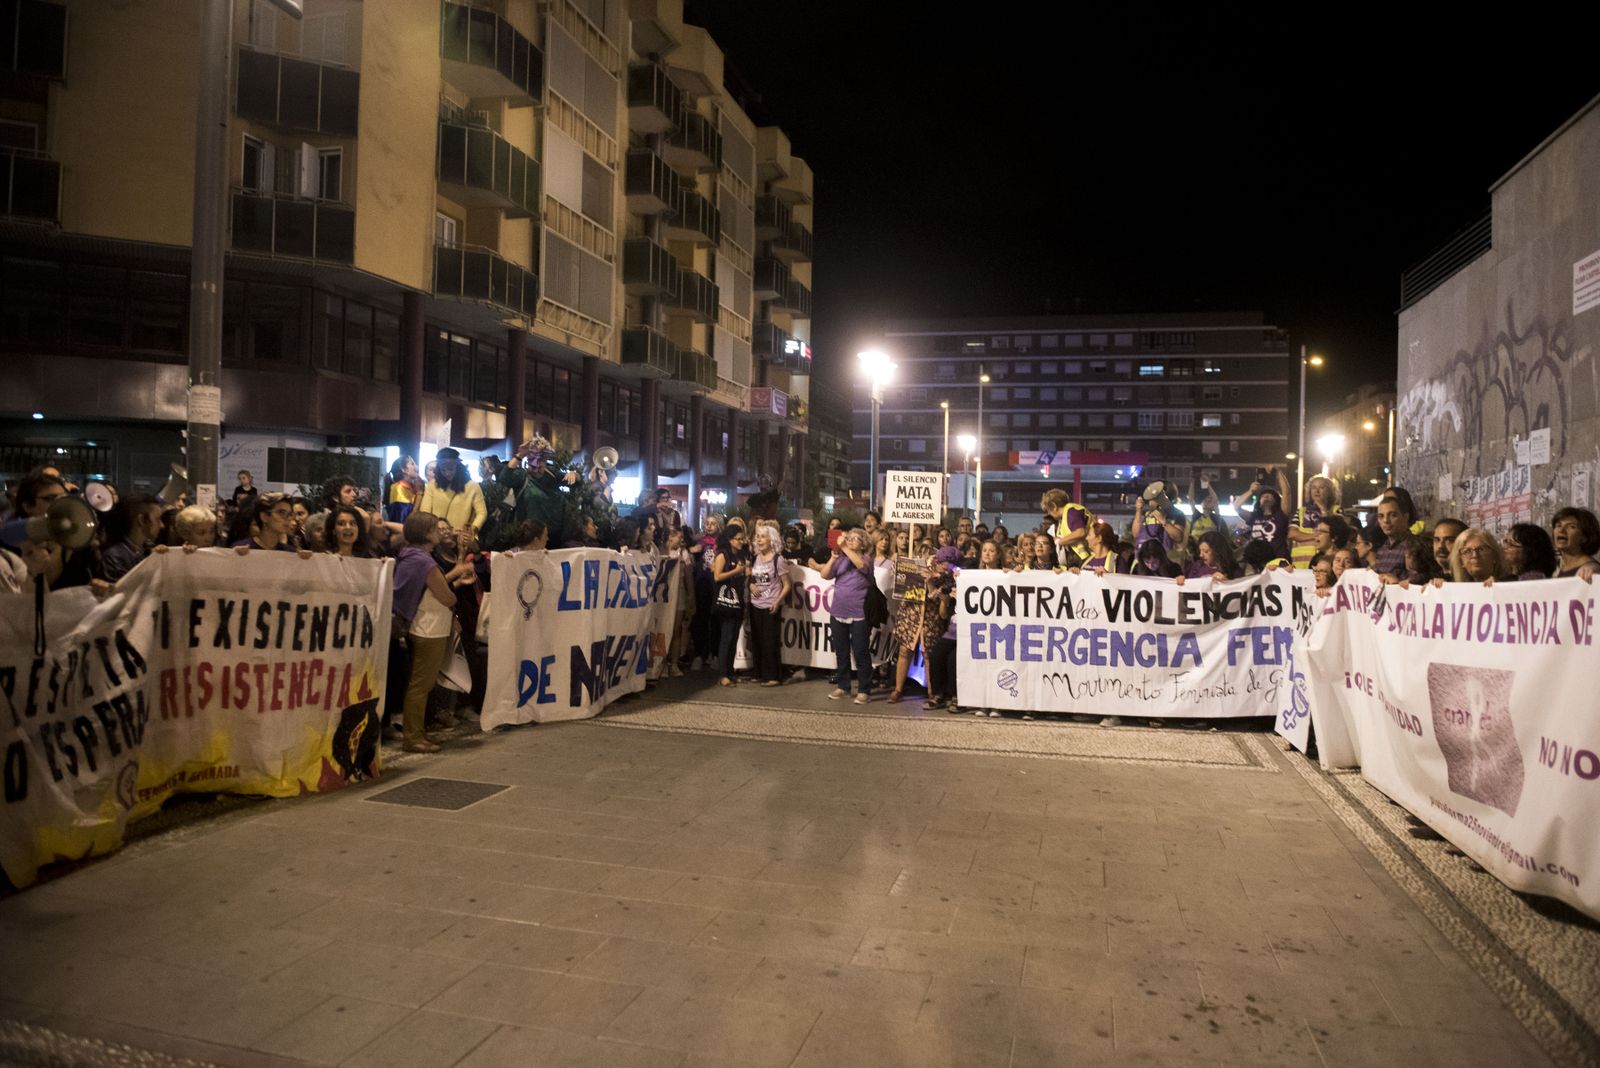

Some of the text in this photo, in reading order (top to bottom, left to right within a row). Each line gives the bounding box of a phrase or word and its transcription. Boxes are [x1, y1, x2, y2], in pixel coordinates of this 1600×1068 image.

[893, 475, 937, 484] EL SILENCIO
[896, 486, 932, 500] MATA
[891, 511, 935, 520] AL AGRESOR
[895, 502, 933, 511] DENUNCIA
[189, 598, 374, 653] EXISTENCIA
[964, 584, 1075, 619] CONTRA
[1101, 584, 1283, 626] VIOLENCIAS
[1451, 600, 1562, 646] VIOLENCIA
[1568, 597, 1595, 646] DE
[970, 622, 1203, 668] EMERGENCIA
[160, 658, 353, 721] RESISTENCIA
